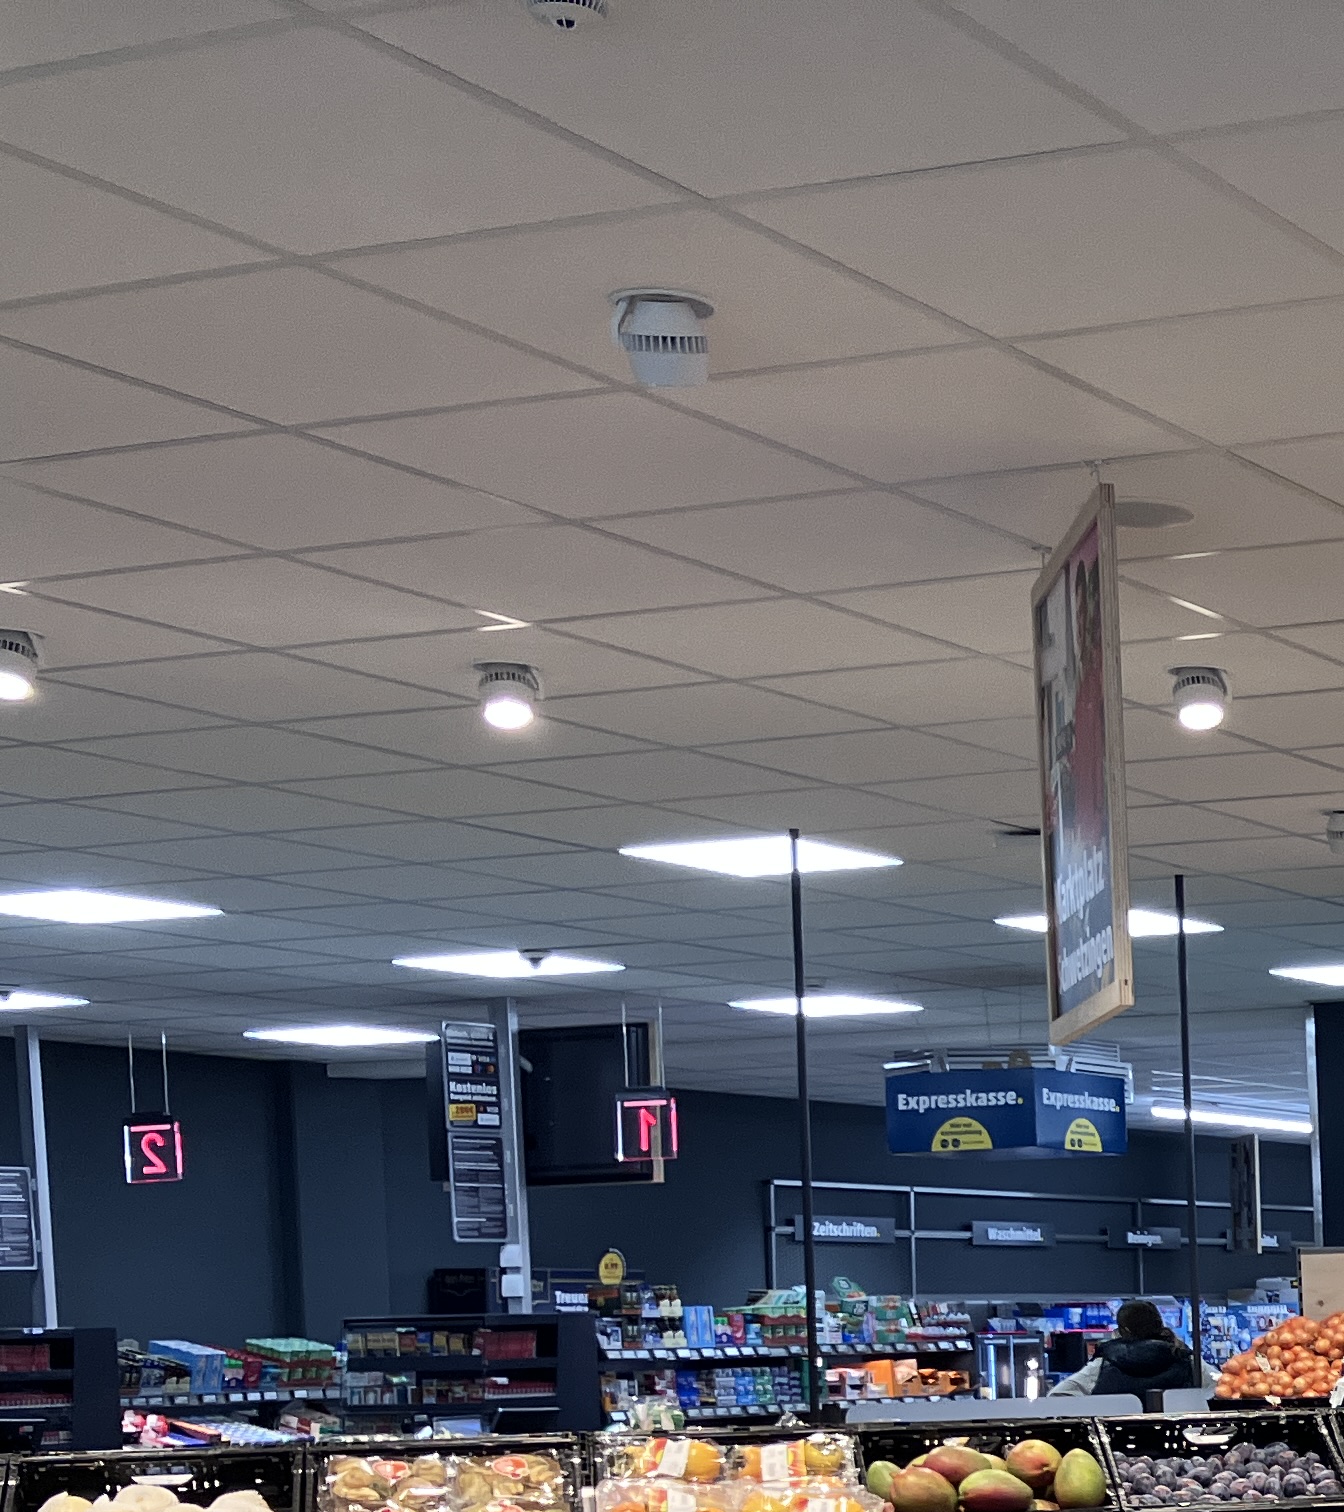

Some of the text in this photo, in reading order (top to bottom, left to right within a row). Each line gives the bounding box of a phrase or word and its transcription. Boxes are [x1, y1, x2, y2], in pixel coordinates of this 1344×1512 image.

[897, 1088, 1024, 1114] Expresskasse.
[1041, 1087, 1121, 1114] Expresskasse.
[812, 1220, 880, 1238] Zeitschriften.
